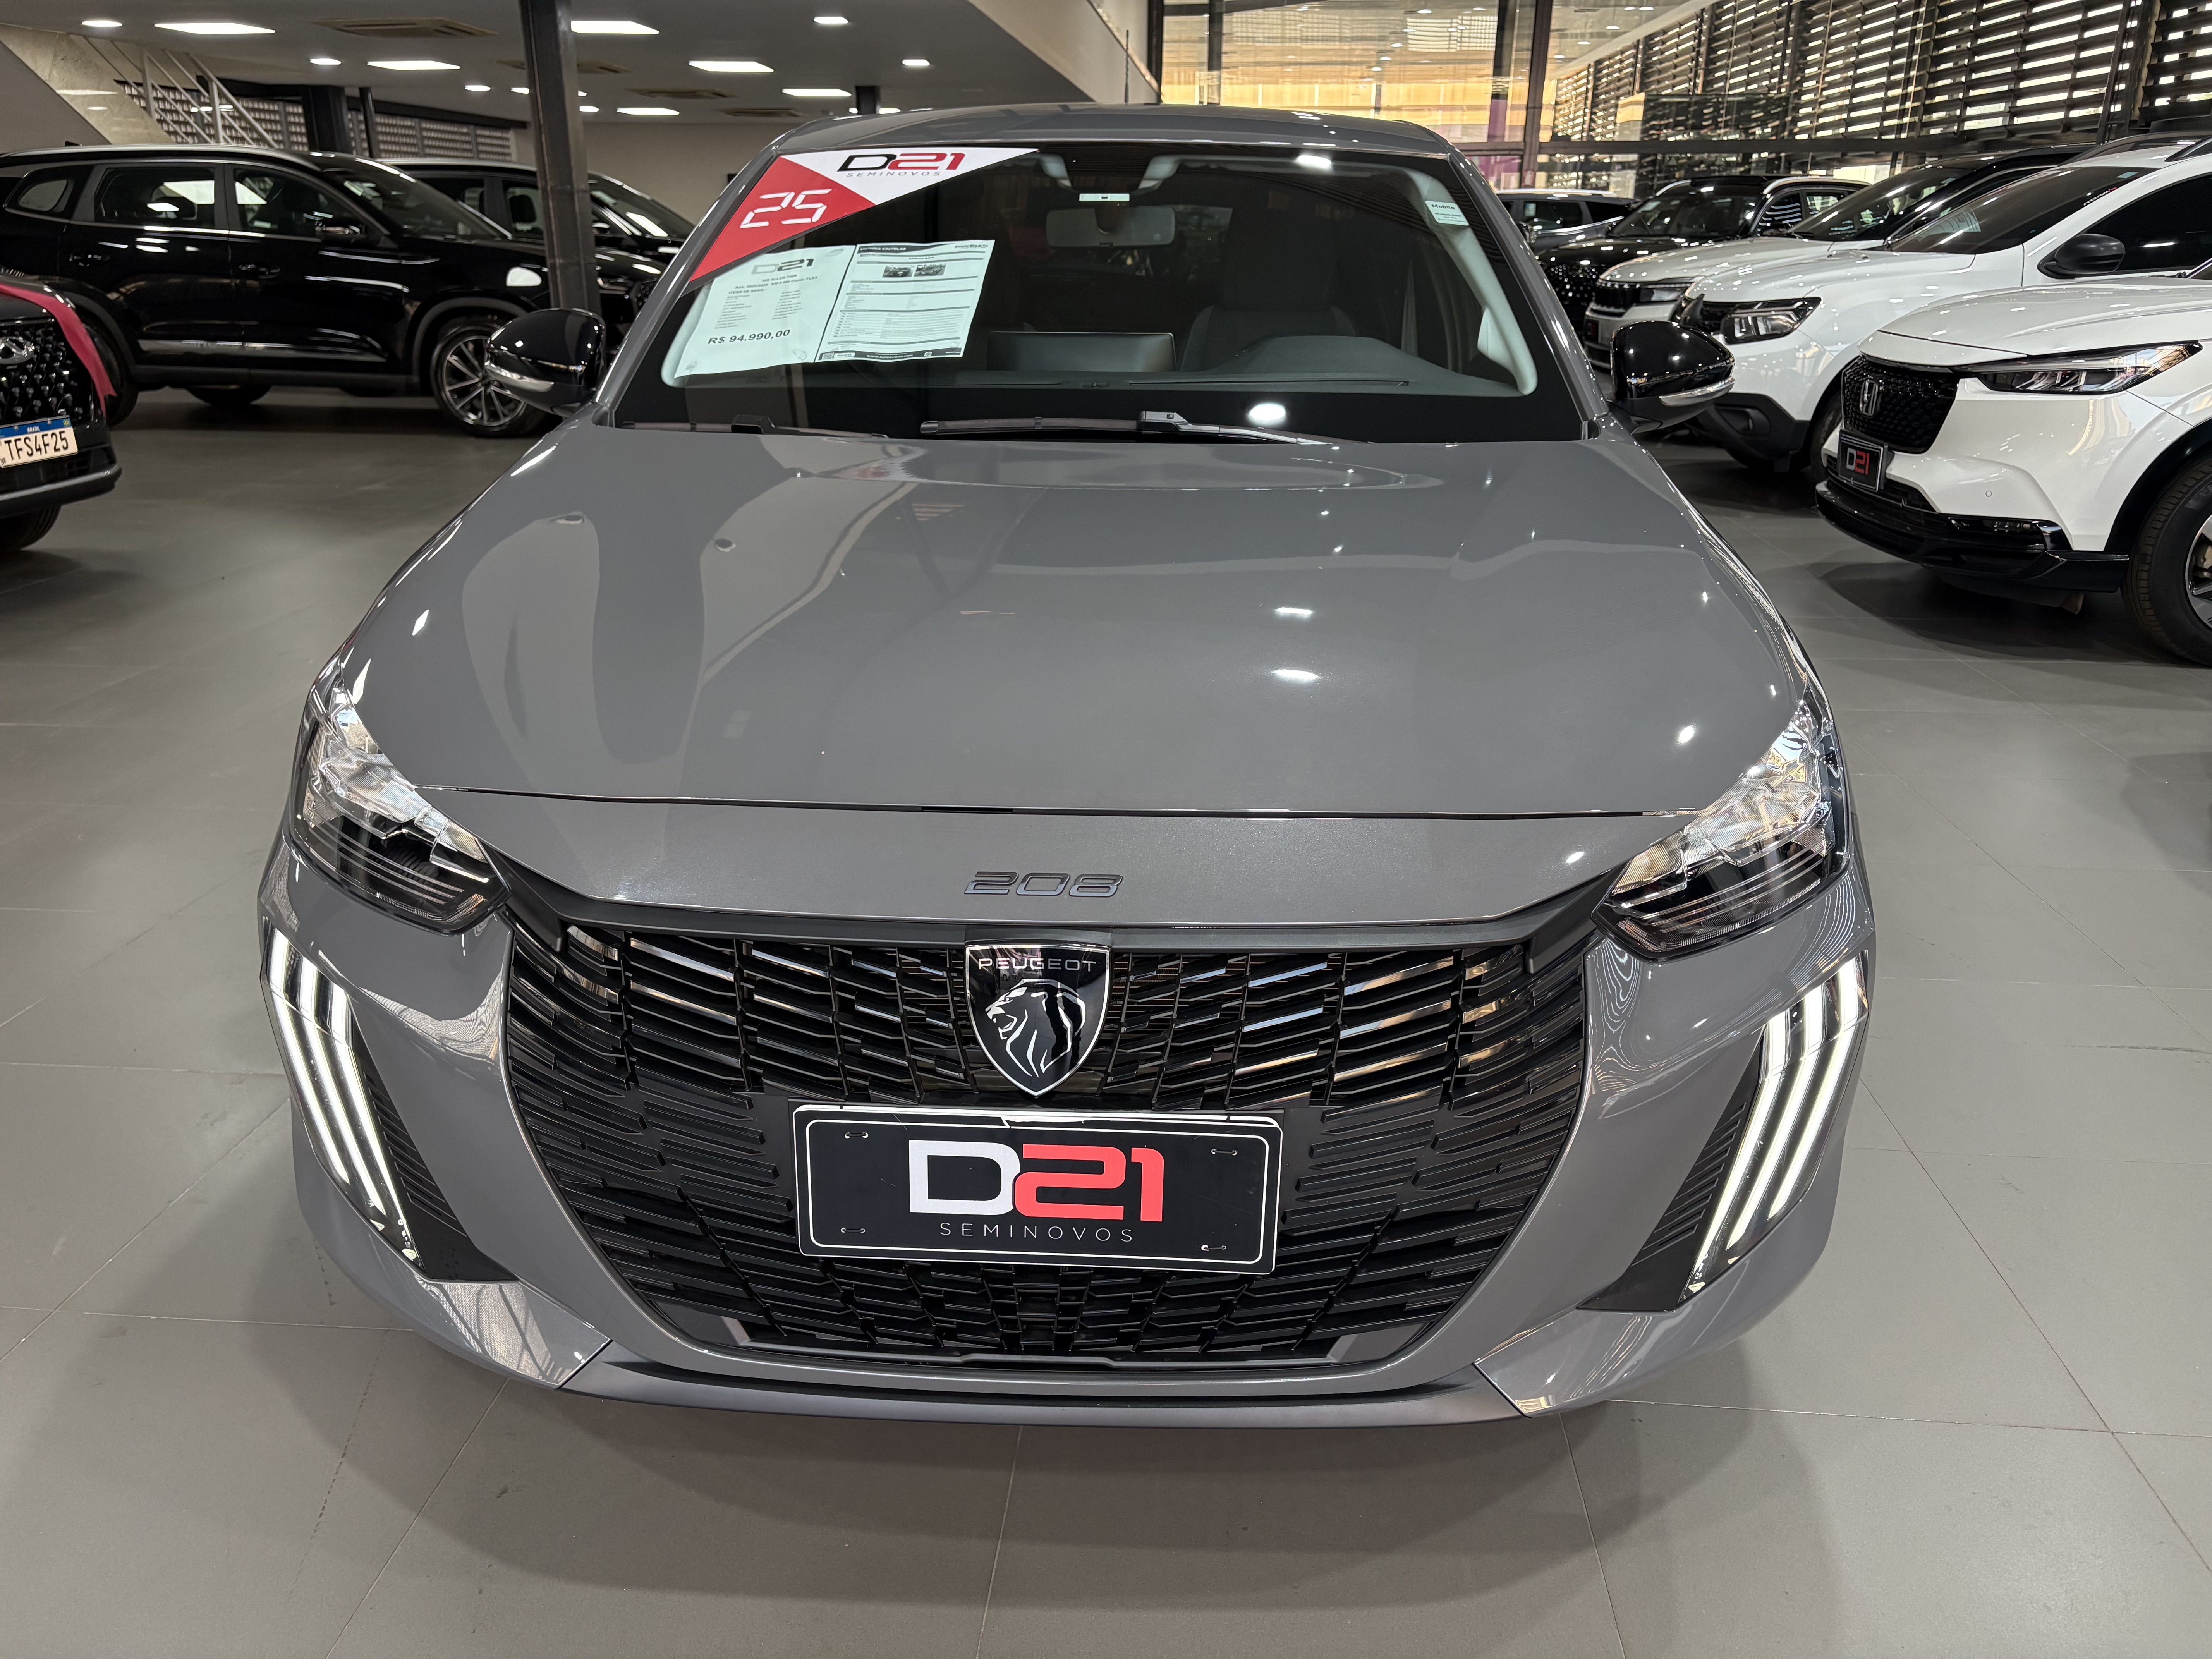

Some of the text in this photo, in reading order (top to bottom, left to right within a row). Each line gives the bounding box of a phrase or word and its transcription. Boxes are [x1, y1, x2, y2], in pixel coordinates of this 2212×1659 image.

[837, 153, 966, 172] D21
[740, 189, 832, 228] 25
[751, 258, 814, 275] D21
[729, 329, 790, 343] 94.990,00
[4, 430, 69, 460] TFS4F25
[1846, 447, 1870, 476] D21
[964, 871, 1123, 897] 208
[978, 958, 1096, 972] PEUGEOT
[909, 1139, 1164, 1222] D21
[939, 1222, 1133, 1242] SEMINOVOS
